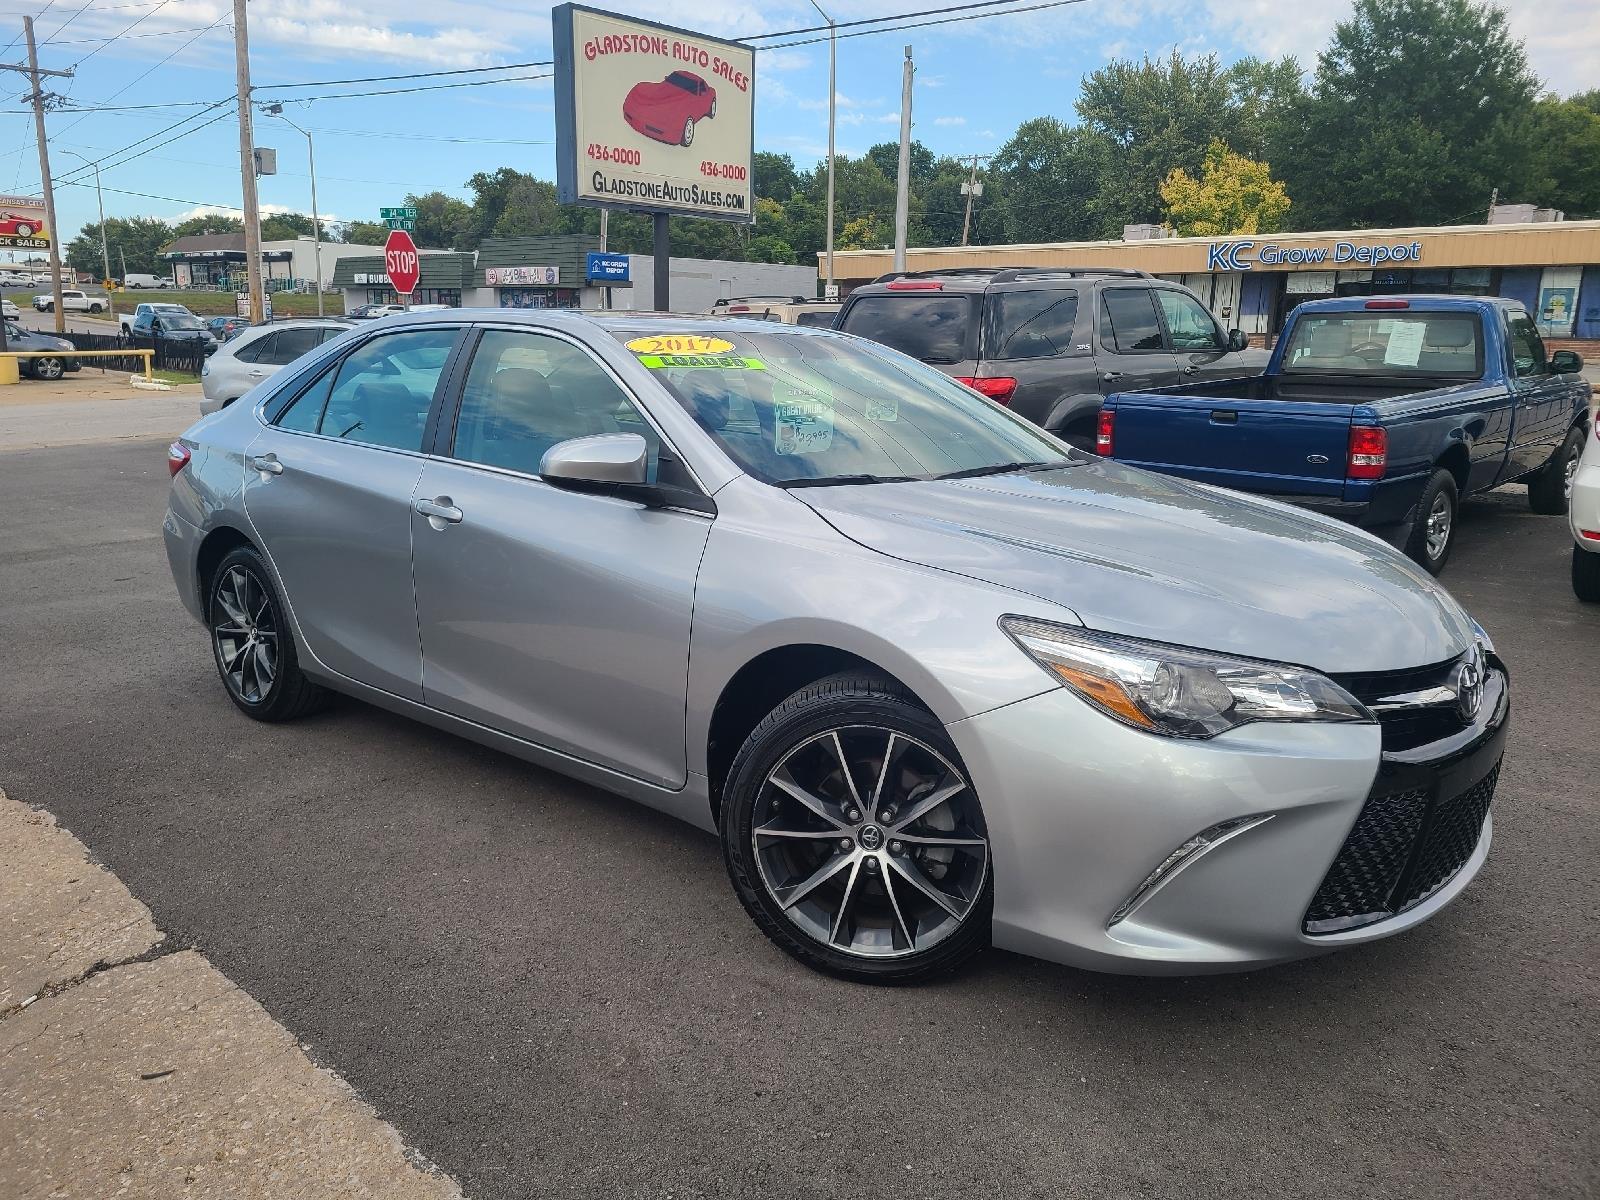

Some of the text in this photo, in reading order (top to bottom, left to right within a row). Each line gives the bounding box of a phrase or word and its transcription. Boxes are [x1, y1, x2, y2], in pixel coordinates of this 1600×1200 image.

[584, 34, 750, 93] GLADSTONE AUTO SALES
[587, 143, 641, 166] 436-0000
[700, 160, 747, 181] 436-0000
[404, 208, 417, 217] TER
[16, 239, 47, 247] SALES
[387, 250, 416, 274] STOP
[1207, 240, 1423, 271] KC Grow Depot
[647, 337, 712, 352] 2017
[659, 356, 751, 368] LOADED
[781, 402, 823, 417] GREAT VALUE
